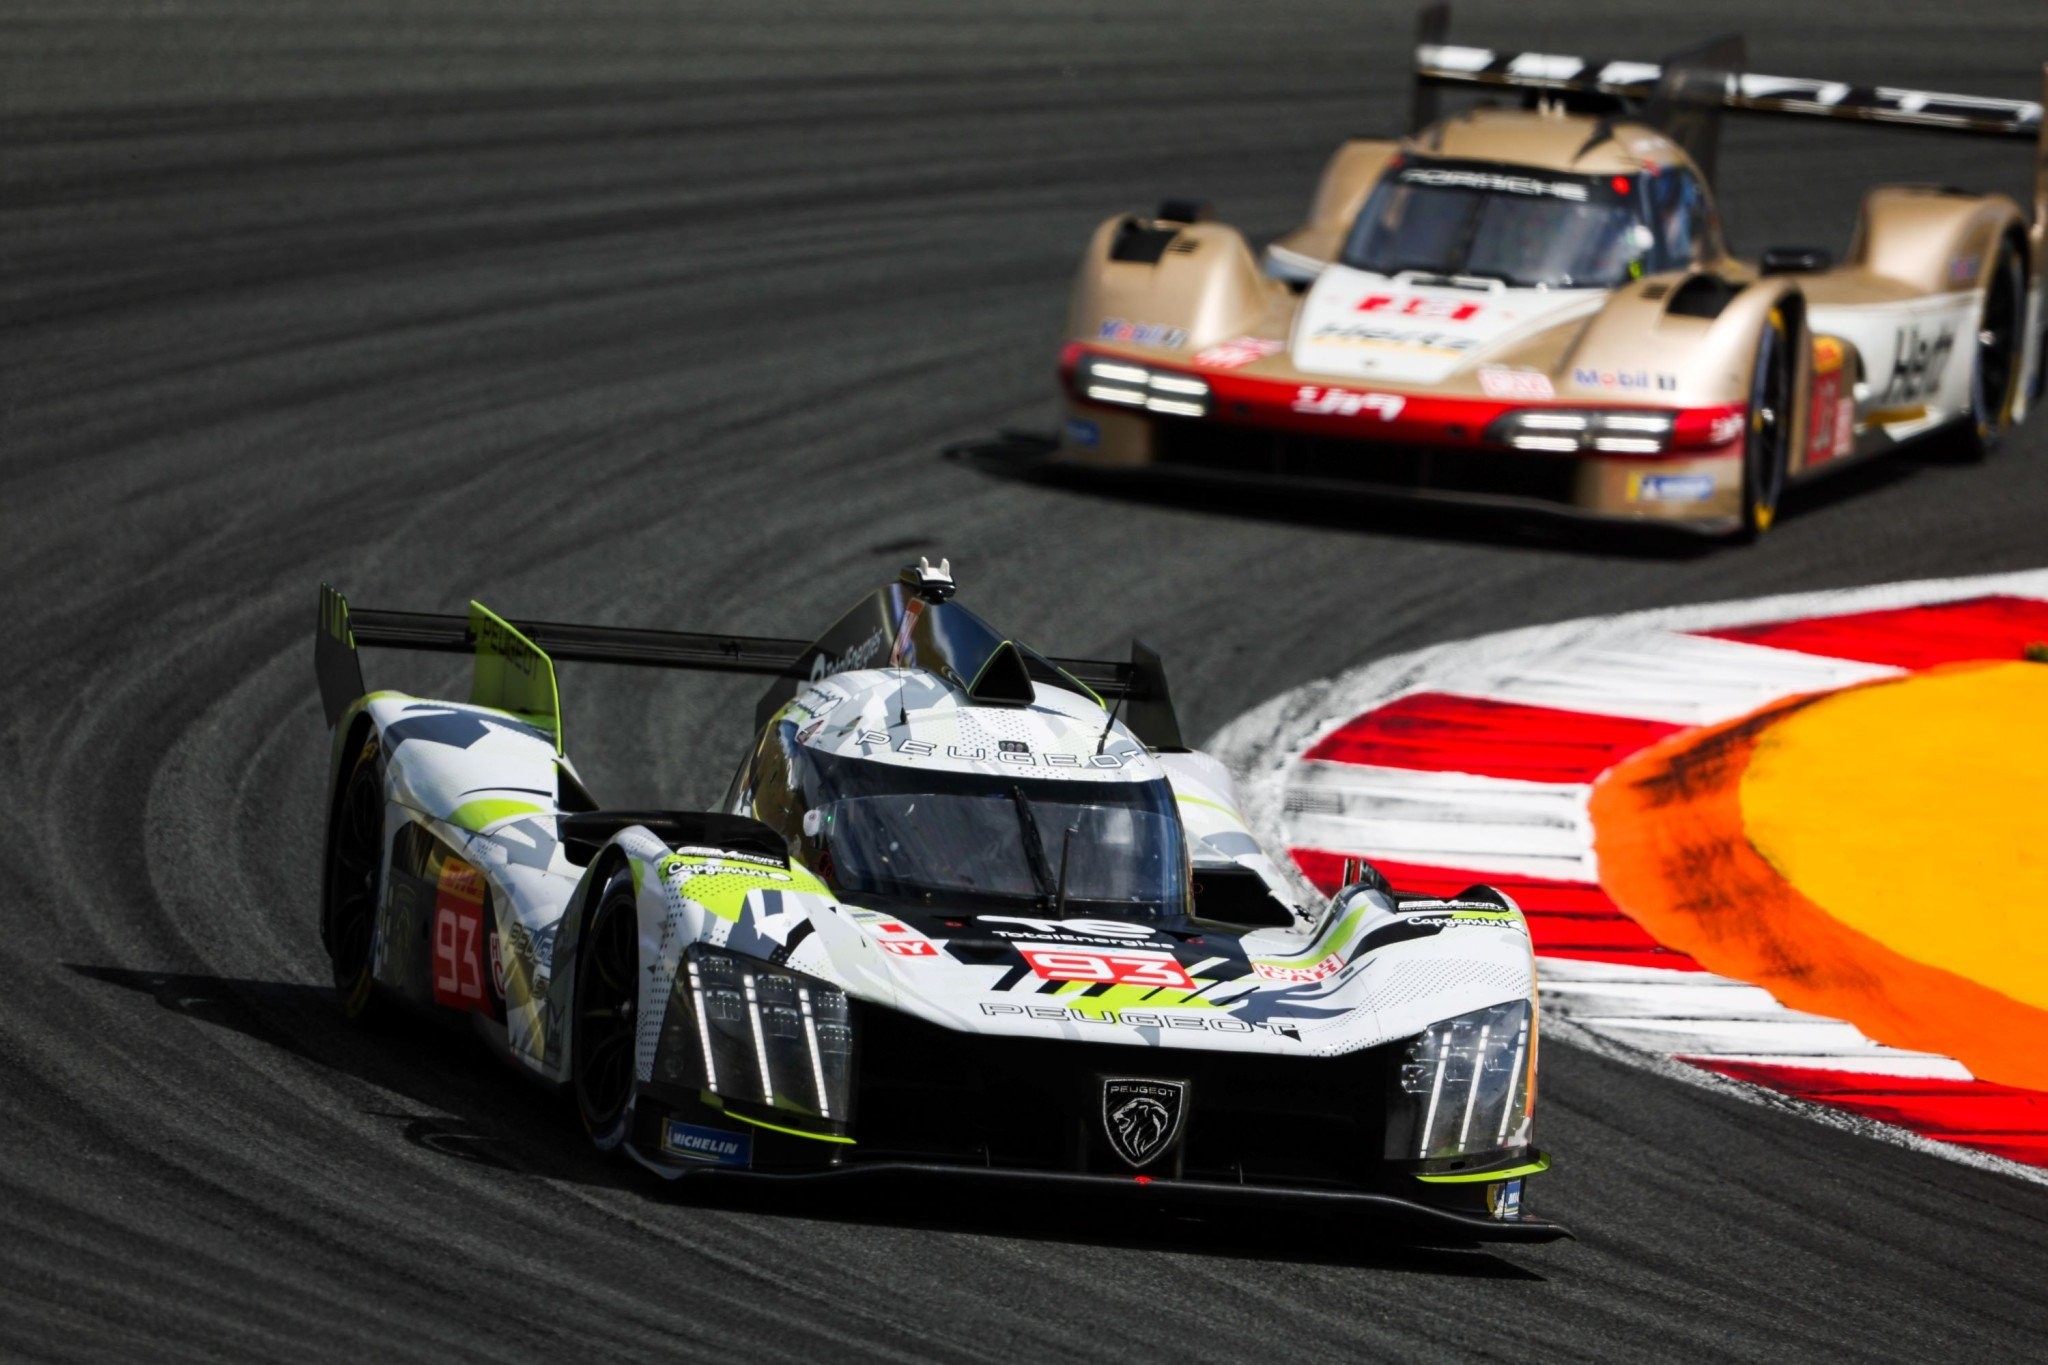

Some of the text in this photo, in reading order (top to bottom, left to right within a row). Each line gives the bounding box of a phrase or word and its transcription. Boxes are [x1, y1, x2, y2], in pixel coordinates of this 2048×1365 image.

[1574, 369, 1649, 388] Mobil
[855, 730, 1147, 769] PEUGEOT
[668, 861, 769, 876] Capgemini
[1407, 917, 1508, 928] Capgemini
[991, 930, 1175, 949] TotalEnergies
[437, 908, 481, 998] 93
[1031, 952, 1185, 986] 93
[979, 1002, 1297, 1036] PEUGEOT
[1110, 1085, 1176, 1097] PEUGEOT
[672, 1133, 739, 1154] MICHELIN
